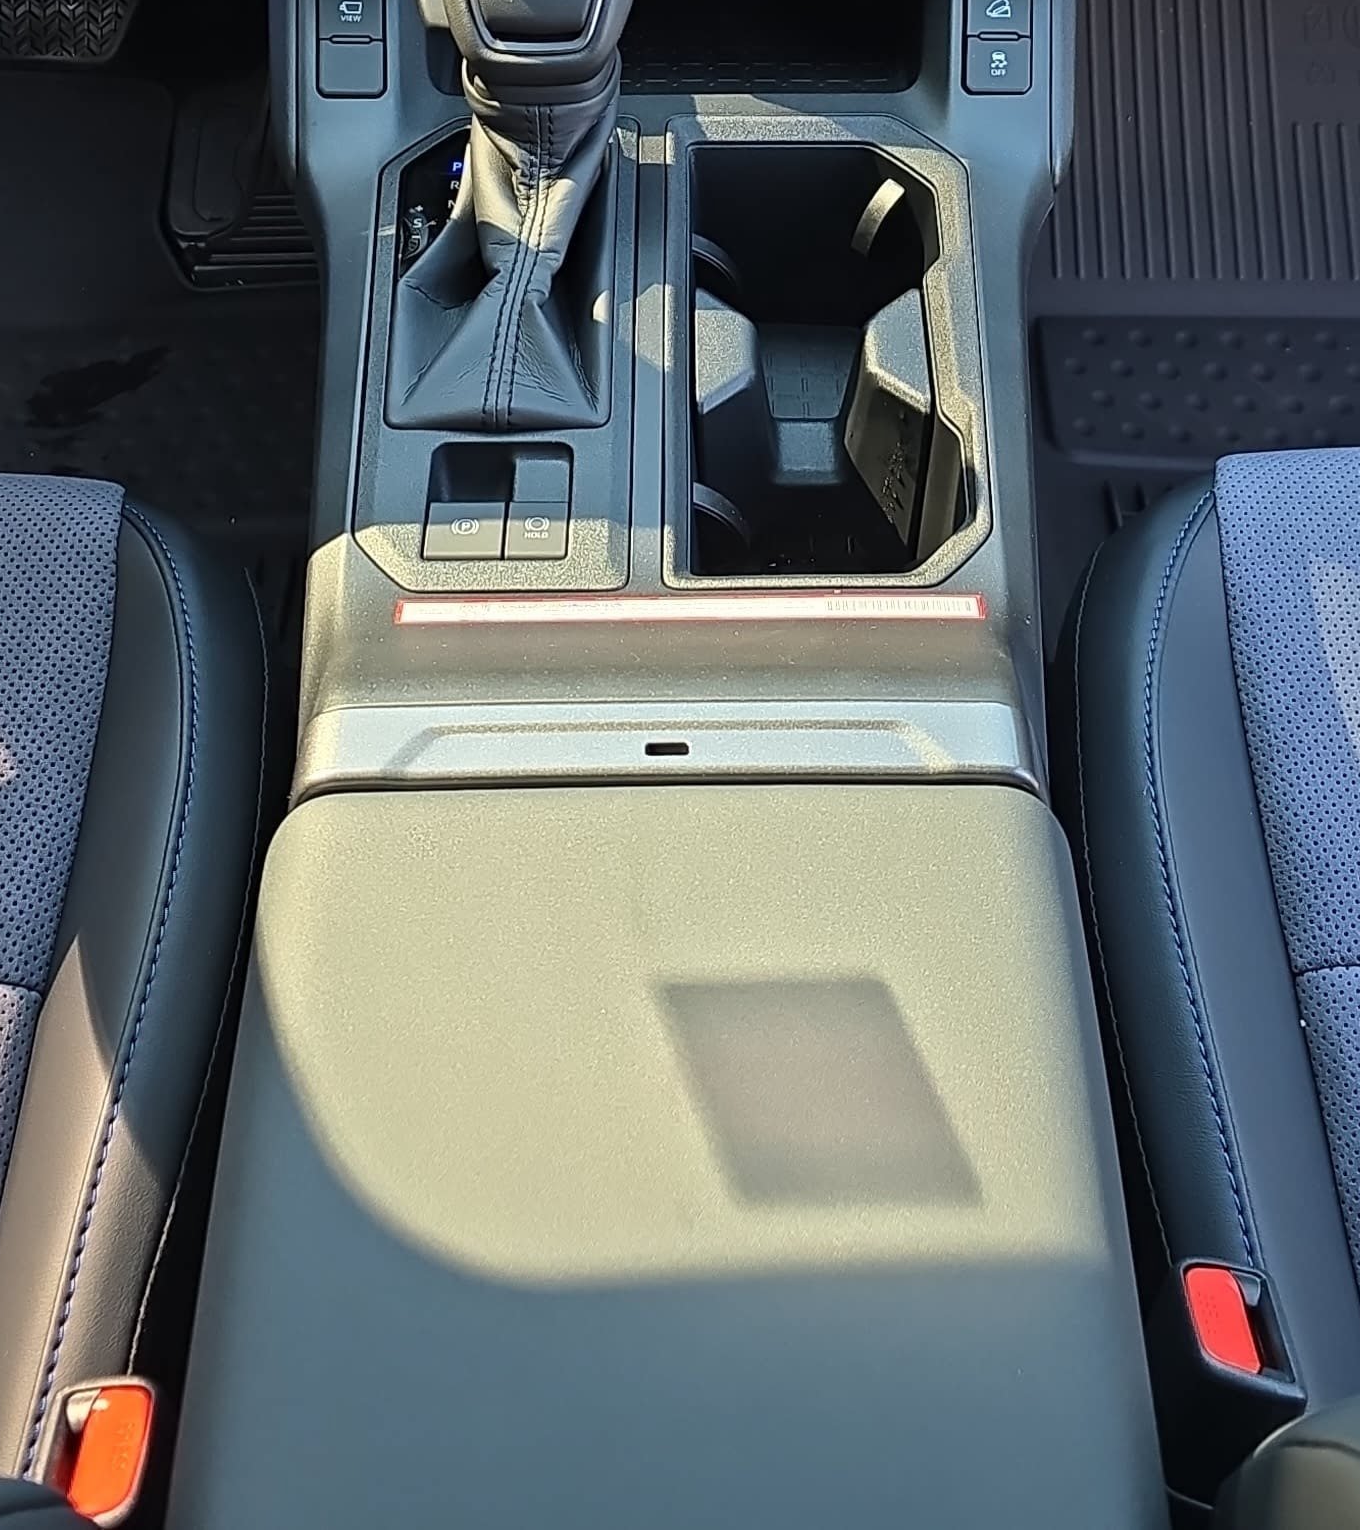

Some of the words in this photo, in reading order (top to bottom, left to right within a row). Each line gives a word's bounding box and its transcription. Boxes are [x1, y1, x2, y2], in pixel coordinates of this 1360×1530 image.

[340, 15, 362, 23] VIEW
[990, 69, 1007, 77] OFF
[452, 162, 462, 172] P
[450, 180, 460, 190] R
[412, 218, 423, 229] S
[524, 531, 549, 539] HOLD
